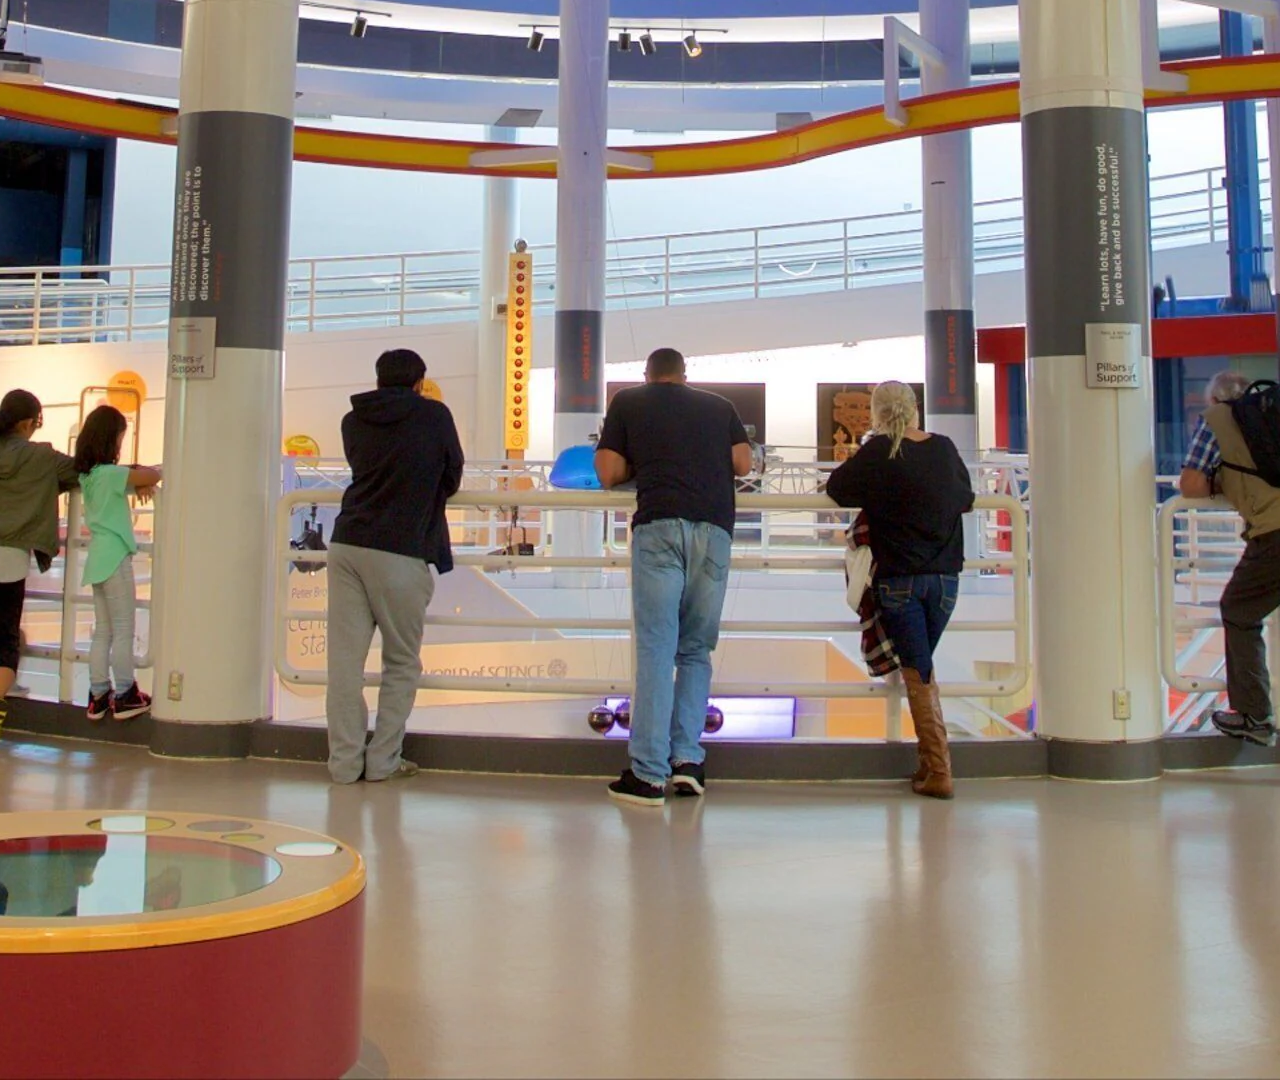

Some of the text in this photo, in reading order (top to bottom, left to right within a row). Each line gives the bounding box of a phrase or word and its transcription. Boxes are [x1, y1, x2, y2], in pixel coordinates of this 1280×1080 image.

[1096, 143, 1107, 174] good,
[1097, 178, 1106, 192] do
[183, 190, 191, 212] they
[1098, 195, 1107, 215] fun,
[1111, 213, 1120, 226] be
[188, 166, 201, 301] discovered; the point is to
[1099, 219, 1107, 244] have
[1112, 230, 1121, 250] and
[1100, 248, 1109, 271] lots,
[1113, 253, 1122, 279] back
[200, 257, 210, 301] discover
[1113, 283, 1124, 305] give
[171, 364, 205, 374] Support
[1096, 362, 1127, 372] Pillars
[1096, 373, 1137, 384] Support
[291, 587, 313, 599] Peter
[488, 665, 545, 677] SCIENCE
